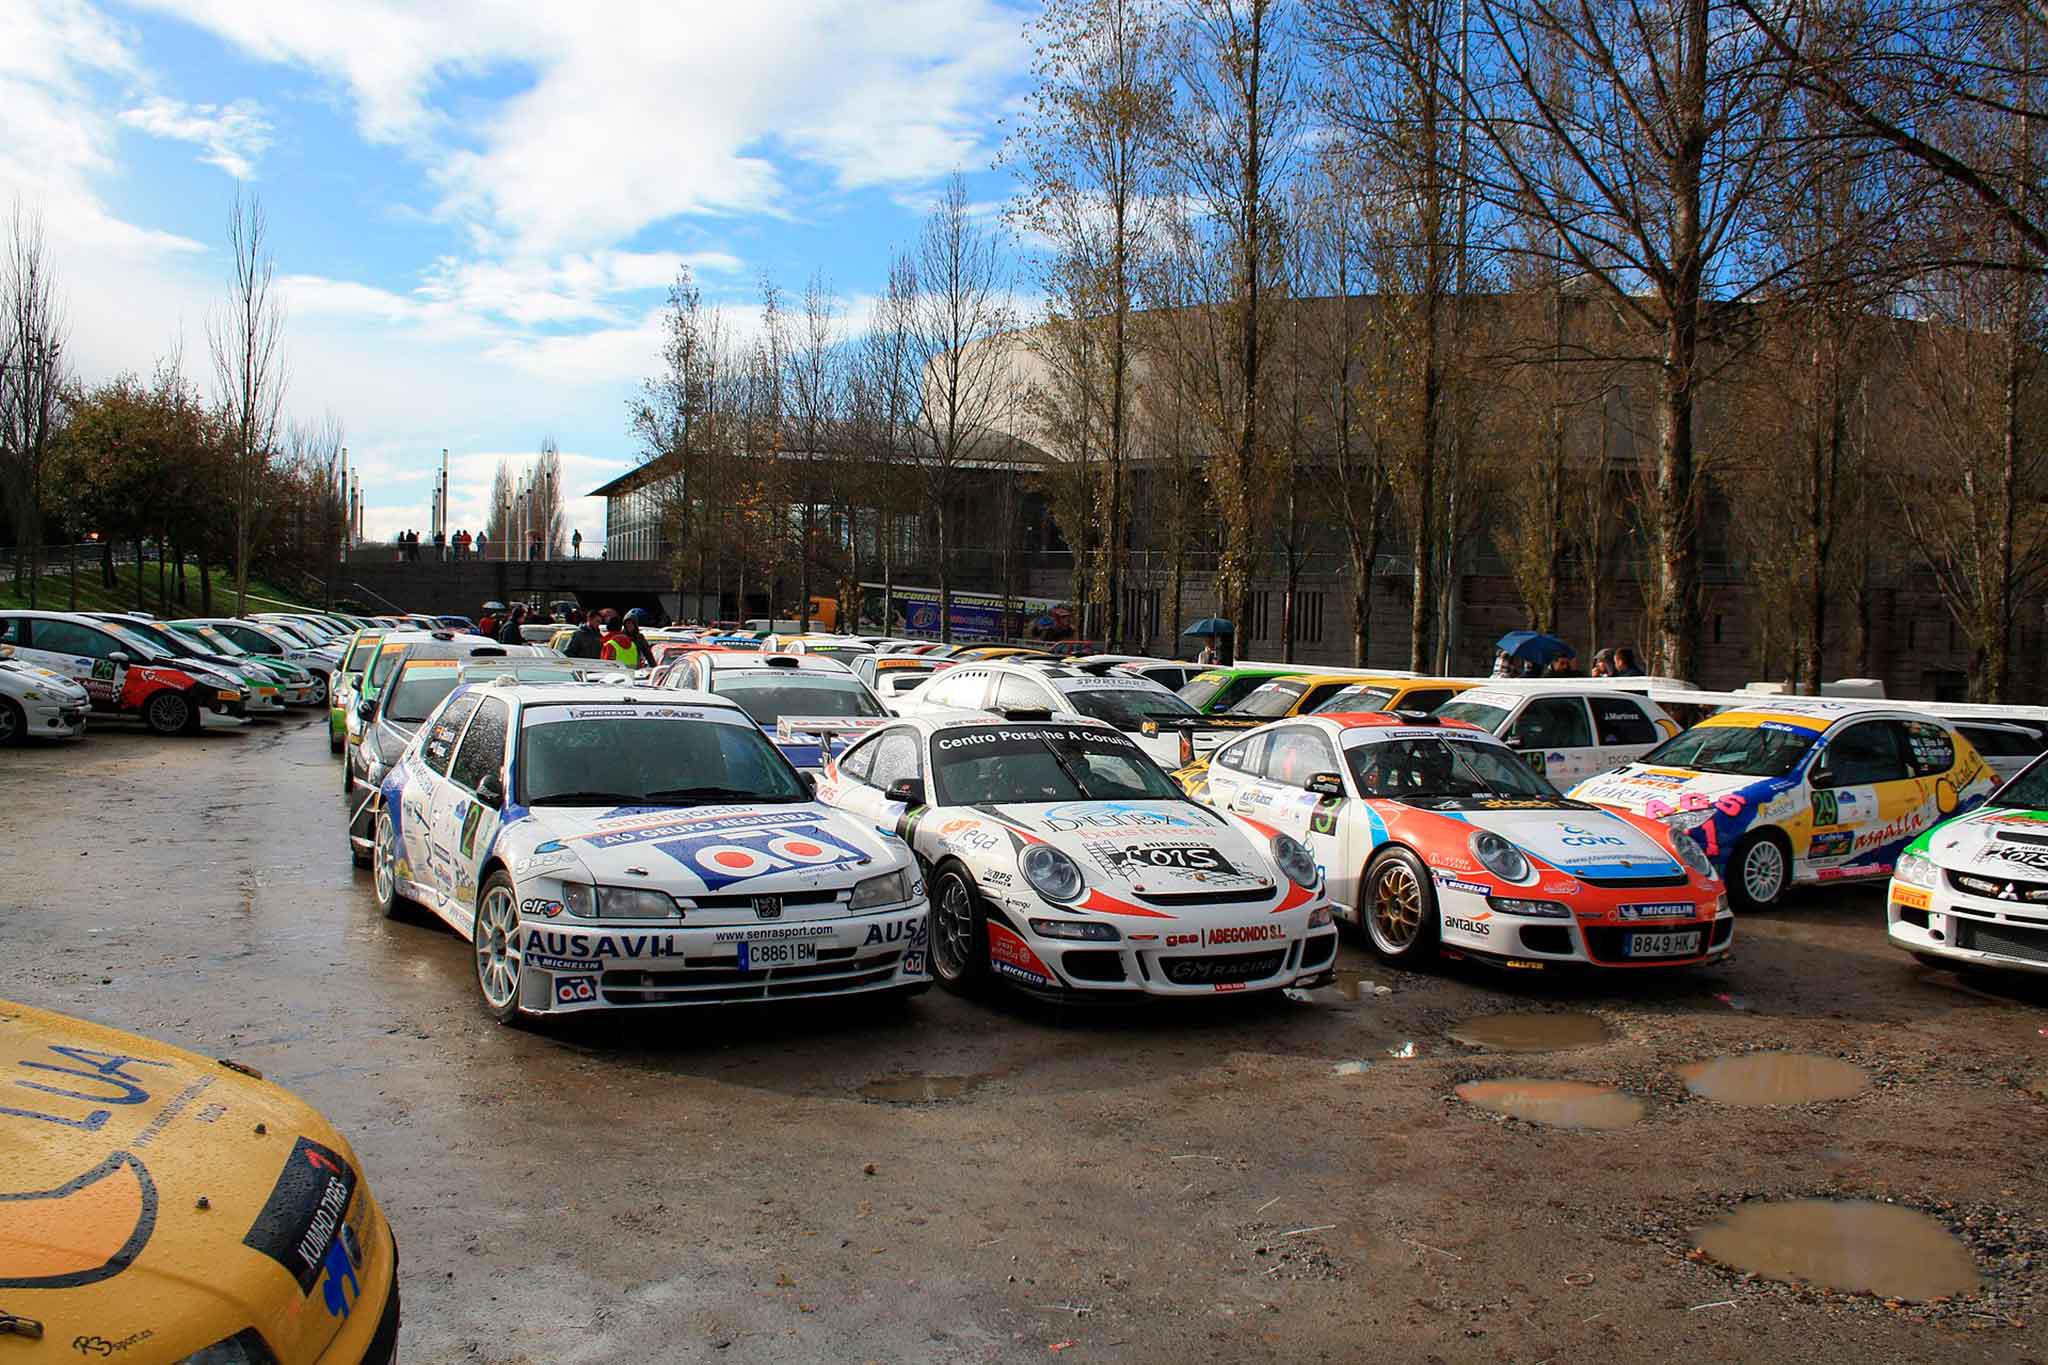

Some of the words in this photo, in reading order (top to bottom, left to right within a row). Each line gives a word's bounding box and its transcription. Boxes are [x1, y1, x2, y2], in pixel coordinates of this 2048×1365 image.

[938, 733, 997, 750] Centro
[999, 730, 1065, 742] Porsche
[1067, 731, 1082, 741] A
[1083, 731, 1136, 748] Coruña
[1813, 791, 1837, 825] 29
[462, 803, 481, 859] 2
[639, 821, 714, 838] GRUPO
[718, 811, 813, 828] REGUEIRA
[1447, 880, 1491, 893] MICHELIN
[520, 898, 547, 915] elf
[1640, 905, 1695, 917] MICHELIN
[525, 928, 684, 958] AUSAVIL
[1208, 925, 1268, 945] ABEGONDO
[1632, 934, 1671, 951] 8849
[542, 959, 599, 969] MICHELIN
[1001, 964, 1045, 984] MICHELIN
[298, 1210, 335, 1269] KUMHO
[320, 1176, 348, 1219] TYRES
